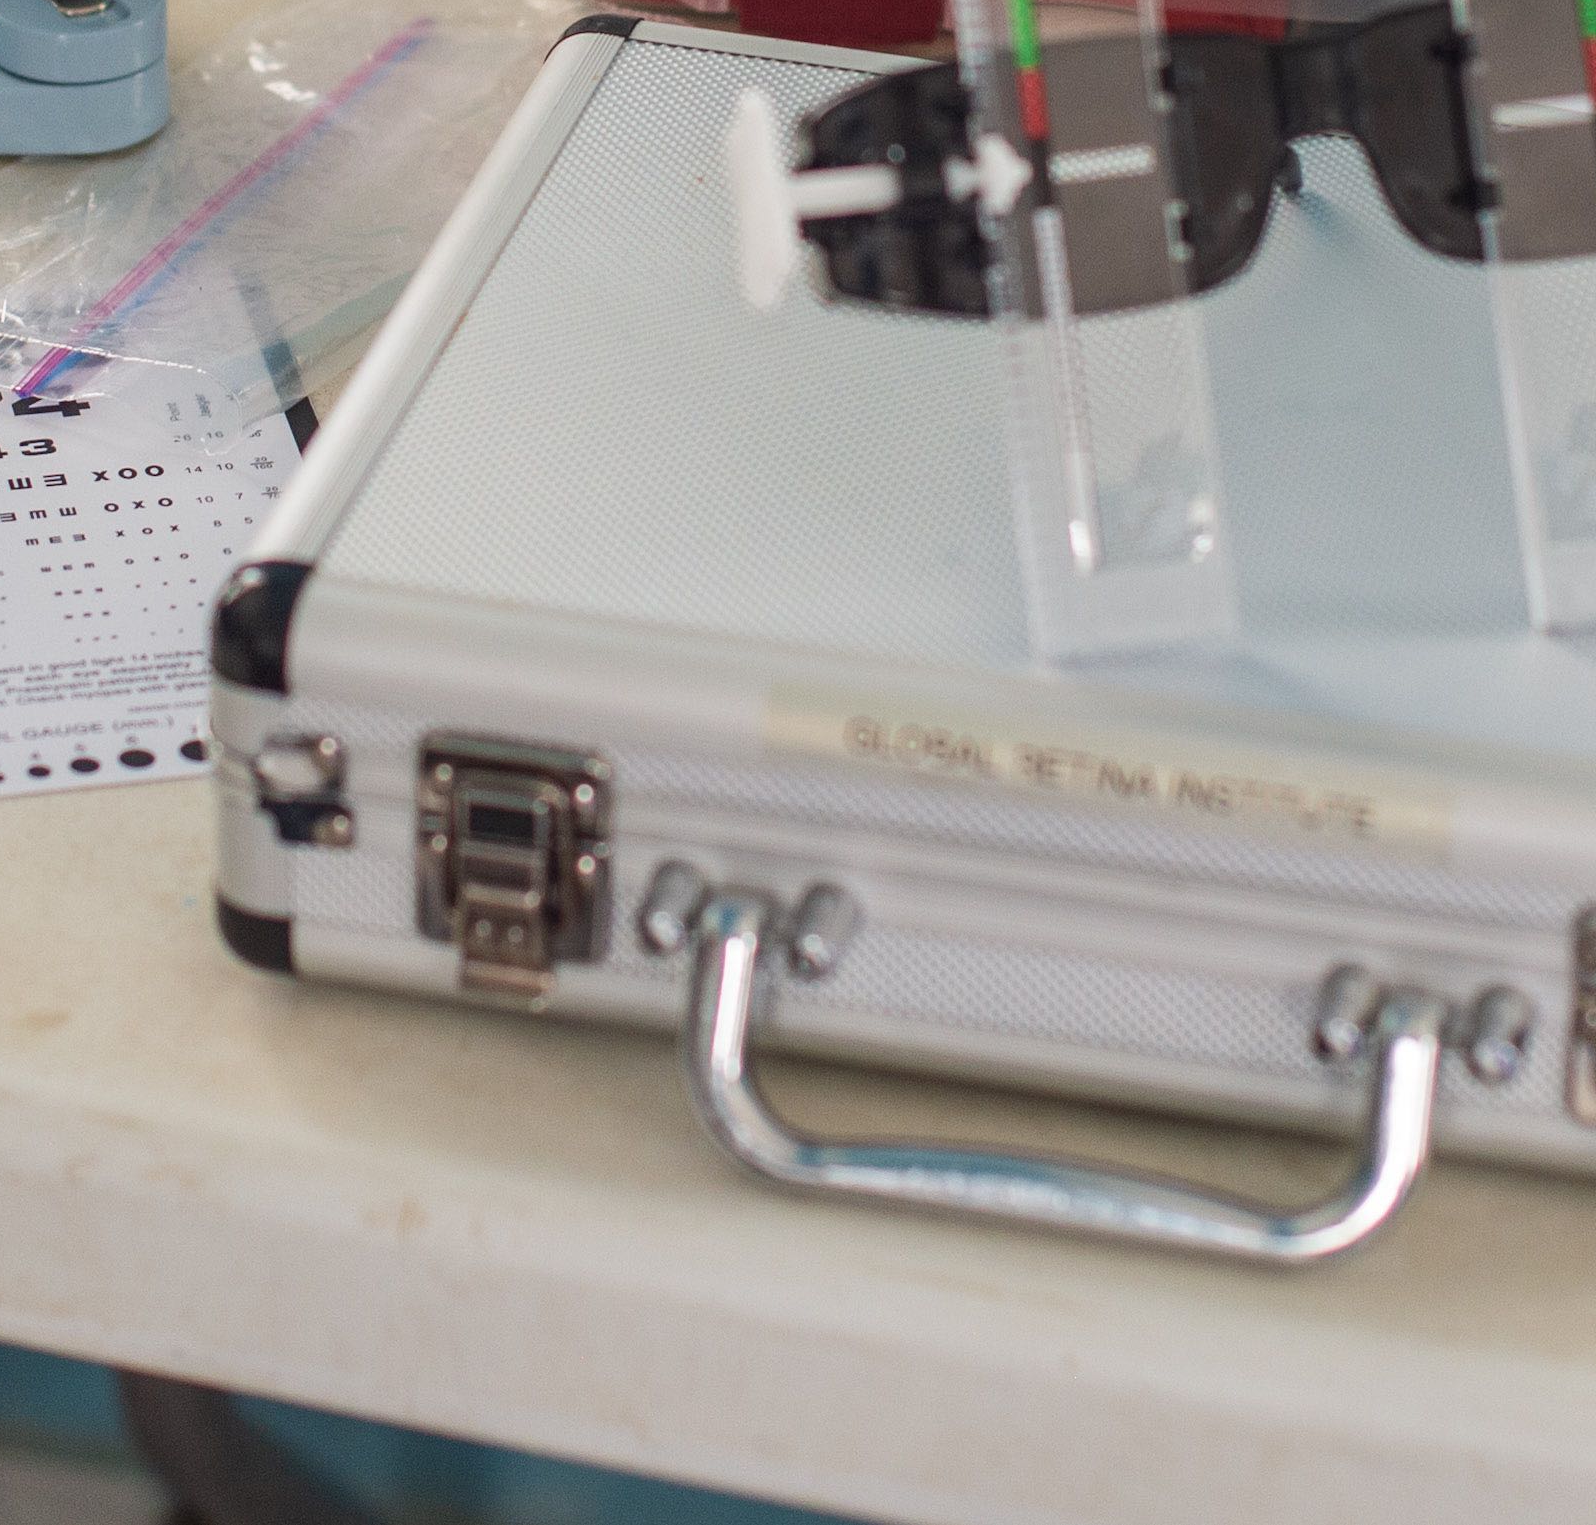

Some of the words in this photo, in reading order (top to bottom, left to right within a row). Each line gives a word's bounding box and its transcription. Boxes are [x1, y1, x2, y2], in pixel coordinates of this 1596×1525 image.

[185, 465, 203, 474] 14
[216, 462, 235, 471] 10
[196, 495, 215, 504] 10
[235, 492, 244, 500] 7
